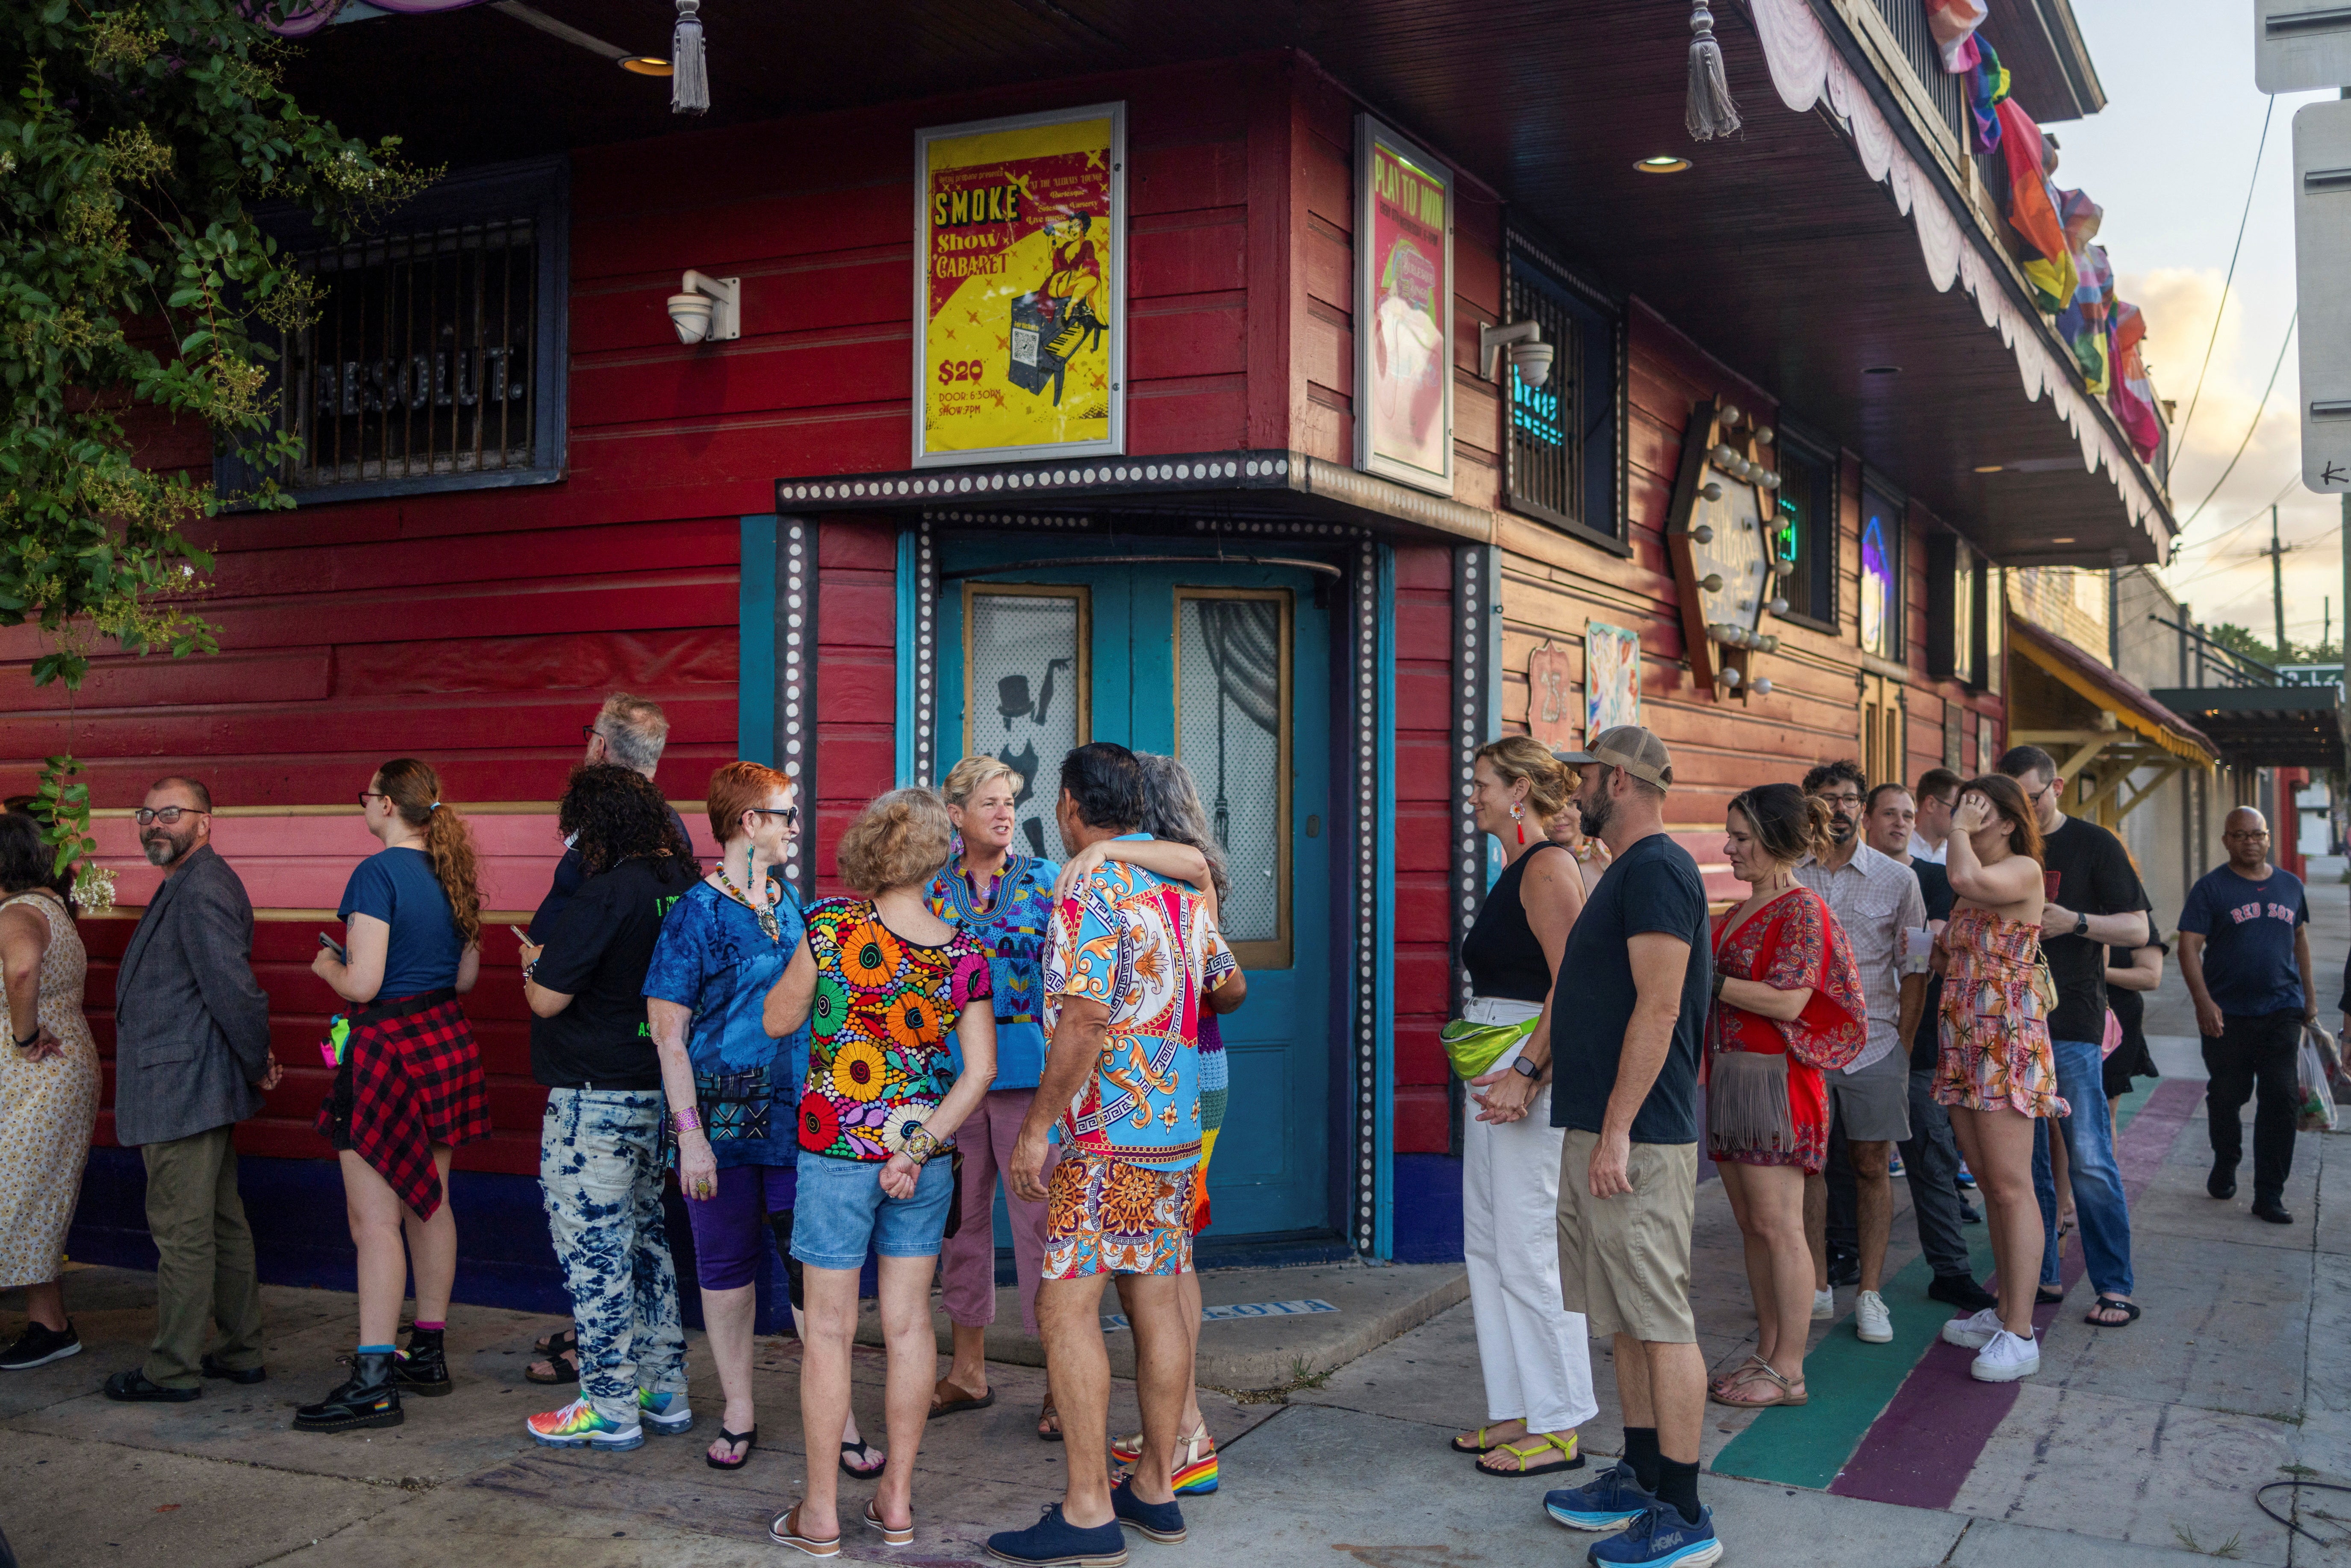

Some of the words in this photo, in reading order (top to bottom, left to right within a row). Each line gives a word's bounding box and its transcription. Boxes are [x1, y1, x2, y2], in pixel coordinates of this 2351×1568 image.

[979, 170, 1004, 180] presents
[1040, 179, 1050, 188] THE
[1080, 173, 1102, 184] LOUNGE
[1049, 189, 1085, 198] Burlesque
[1375, 154, 1399, 205] PLAY
[1401, 174, 1417, 216] TO
[1420, 184, 1443, 231] WIN
[934, 184, 1019, 227] SMOKE
[1026, 216, 1043, 225] Live
[937, 232, 1000, 253] Show
[936, 253, 1009, 278] CABARET
[1410, 277, 1427, 300] BINGO
[938, 360, 983, 385] $20
[939, 392, 968, 402] DOOR:
[970, 389, 1001, 399] 6:30PM
[2230, 902, 2260, 924] RED
[2268, 902, 2294, 925] SOX
[1651, 1531, 1683, 1553] HOKA
